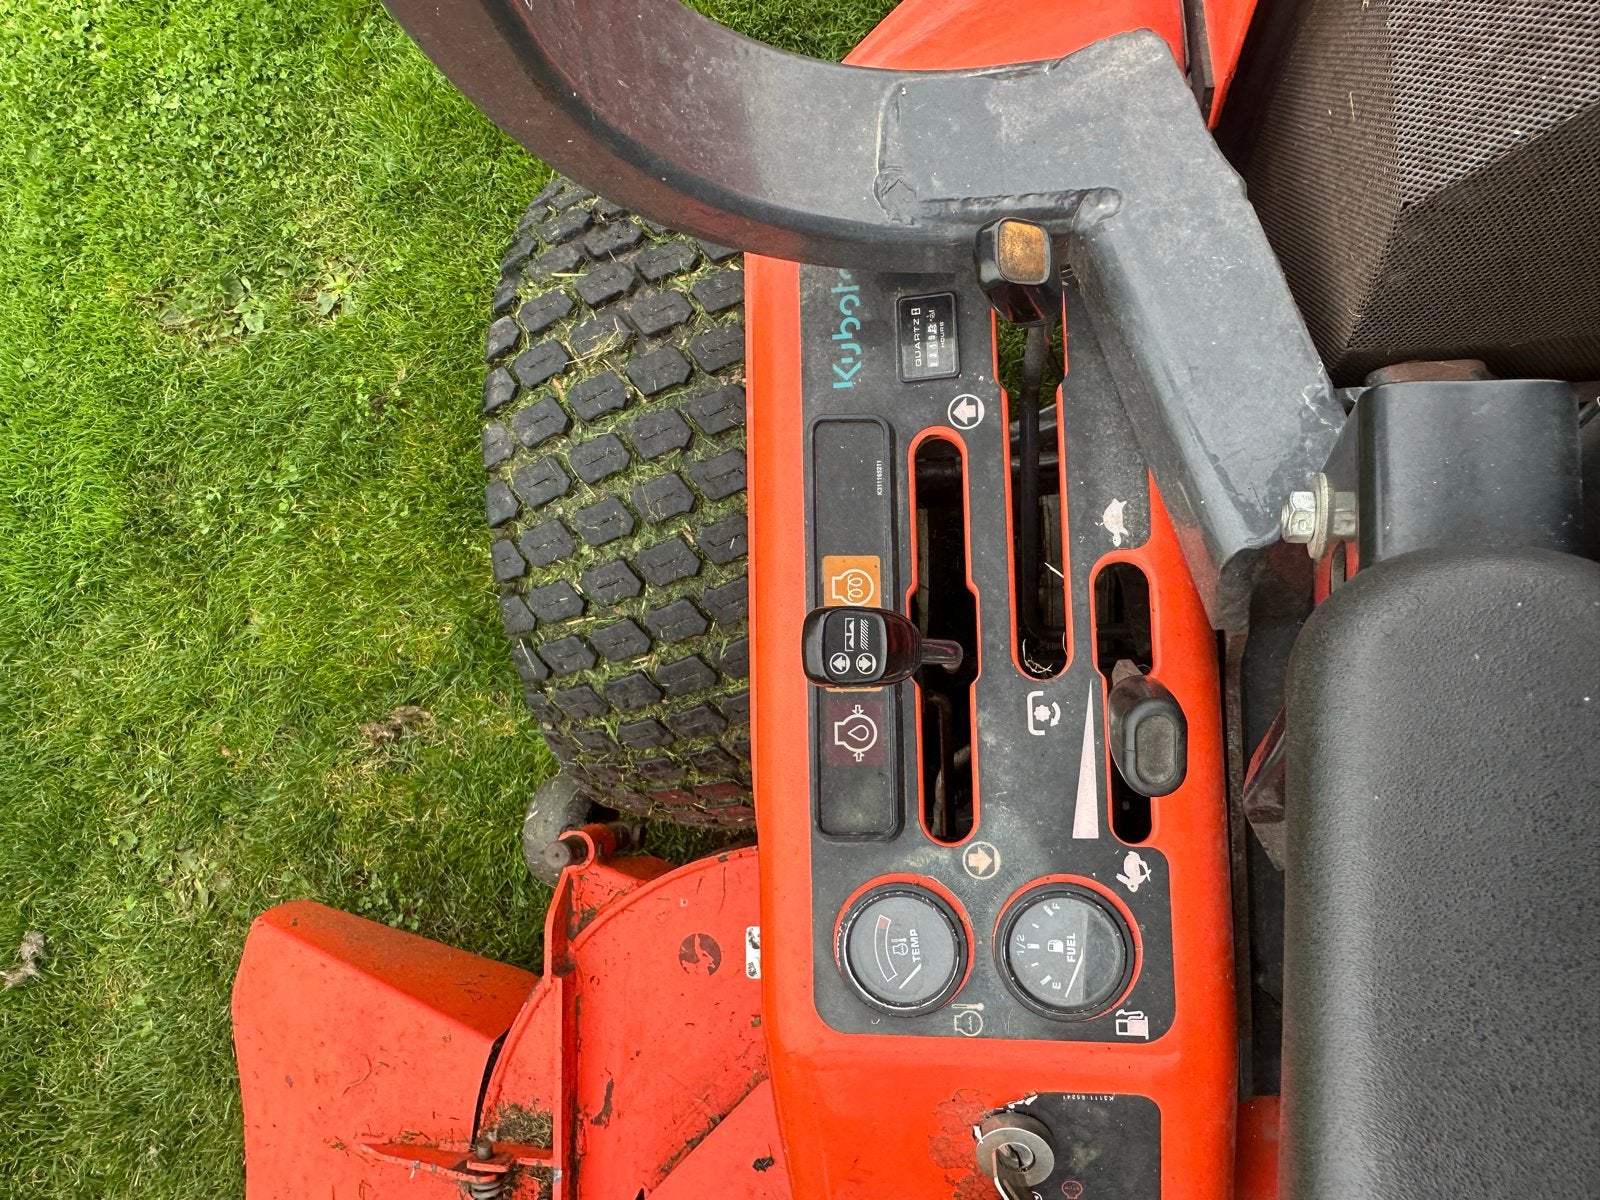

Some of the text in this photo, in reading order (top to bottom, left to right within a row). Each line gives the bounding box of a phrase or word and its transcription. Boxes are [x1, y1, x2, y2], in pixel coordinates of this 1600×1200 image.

[913, 318, 922, 367] QUARTZ
[1051, 902, 1061, 910] F
[909, 928, 921, 963] TEMP
[1016, 934, 1026, 956] 1/2
[1066, 932, 1077, 963] FUEL
[1052, 981, 1061, 990] E
